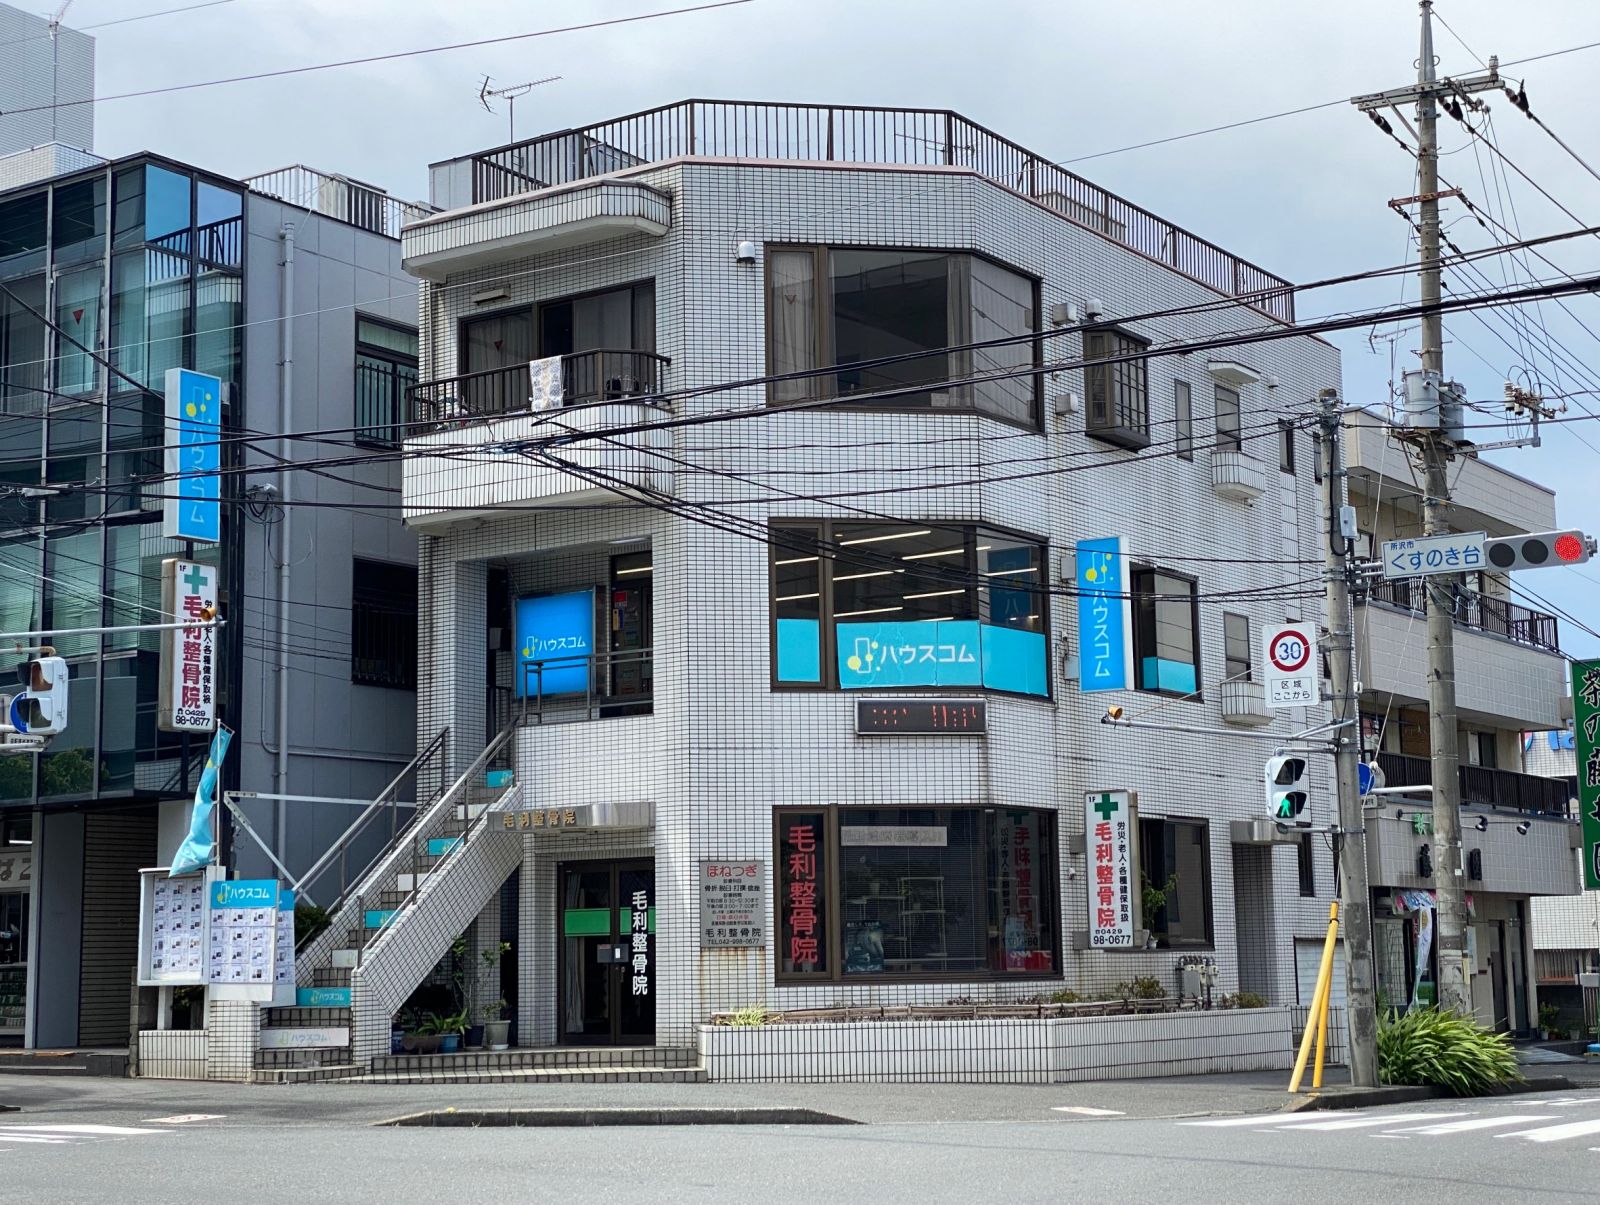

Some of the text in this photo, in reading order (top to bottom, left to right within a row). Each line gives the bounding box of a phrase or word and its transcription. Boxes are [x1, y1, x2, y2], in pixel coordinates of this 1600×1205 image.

[190, 427, 205, 523] ハウスコム
[1390, 541, 1414, 550] 所沢市
[1391, 545, 1480, 570] くすのき台
[1092, 588, 1111, 678] ハウスコム
[181, 596, 202, 710] 毛利整骨院
[539, 636, 586, 652] ハウスコム
[1279, 642, 1302, 660] 30
[881, 644, 976, 664] ハウスコム
[1281, 680, 1302, 689] 区域
[1274, 690, 1310, 700] ここから
[175, 716, 210, 727] 98-0677
[503, 809, 577, 828] 毛利整骨院
[707, 864, 757, 878] ほねつぎ
[1095, 821, 1116, 928] 毛利整骨院
[230, 887, 270, 899] ハウスコム
[788, 825, 818, 964] 毛利整骨院
[705, 928, 761, 938] 毛利整骨院
[1093, 935, 1131, 945] 98-0677
[632, 890, 648, 996] 毛利整骨院
